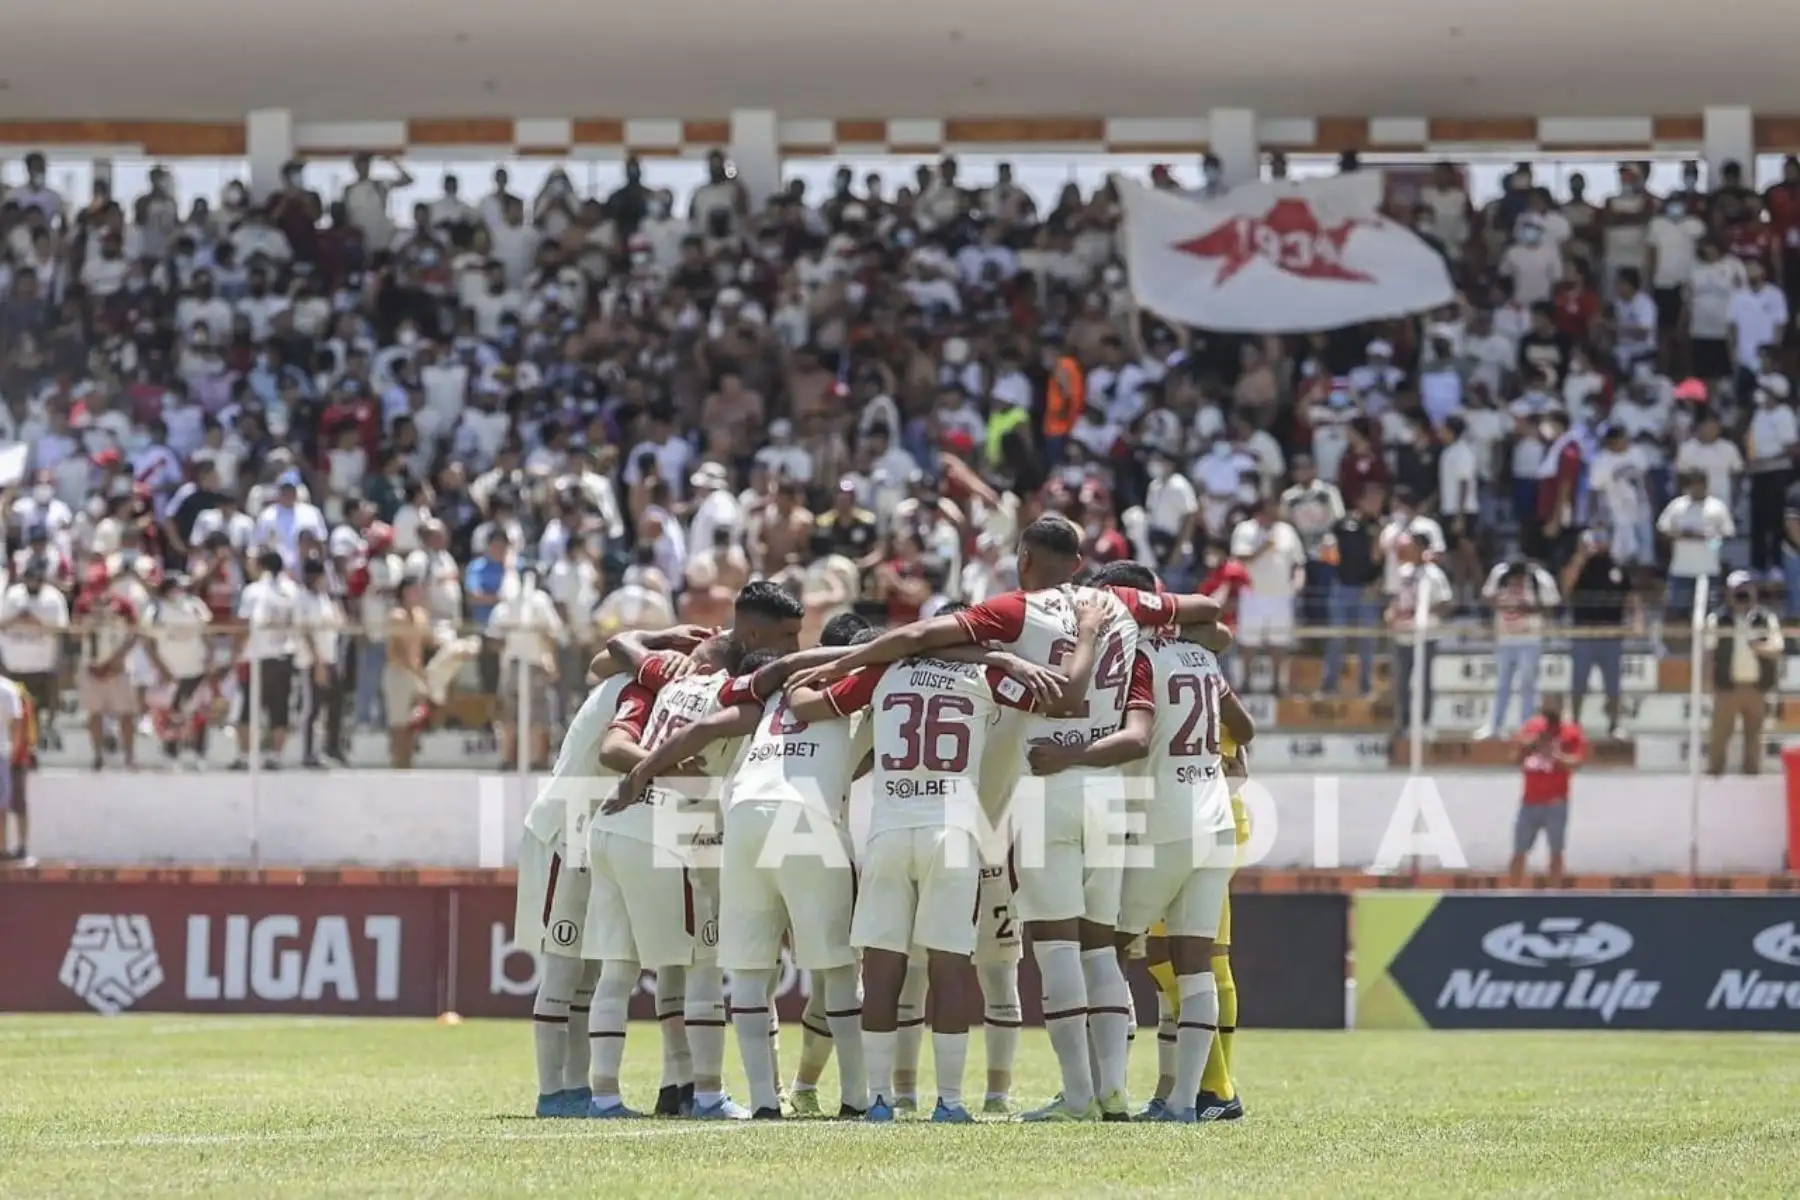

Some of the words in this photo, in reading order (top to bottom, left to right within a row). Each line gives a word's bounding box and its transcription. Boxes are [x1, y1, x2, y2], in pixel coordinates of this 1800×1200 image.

[881, 693, 974, 772] 36
[749, 742, 819, 762] SOLBET
[885, 778, 959, 799] SOLBET
[1436, 968, 1564, 1010] New
[1563, 968, 1662, 1024] Life
